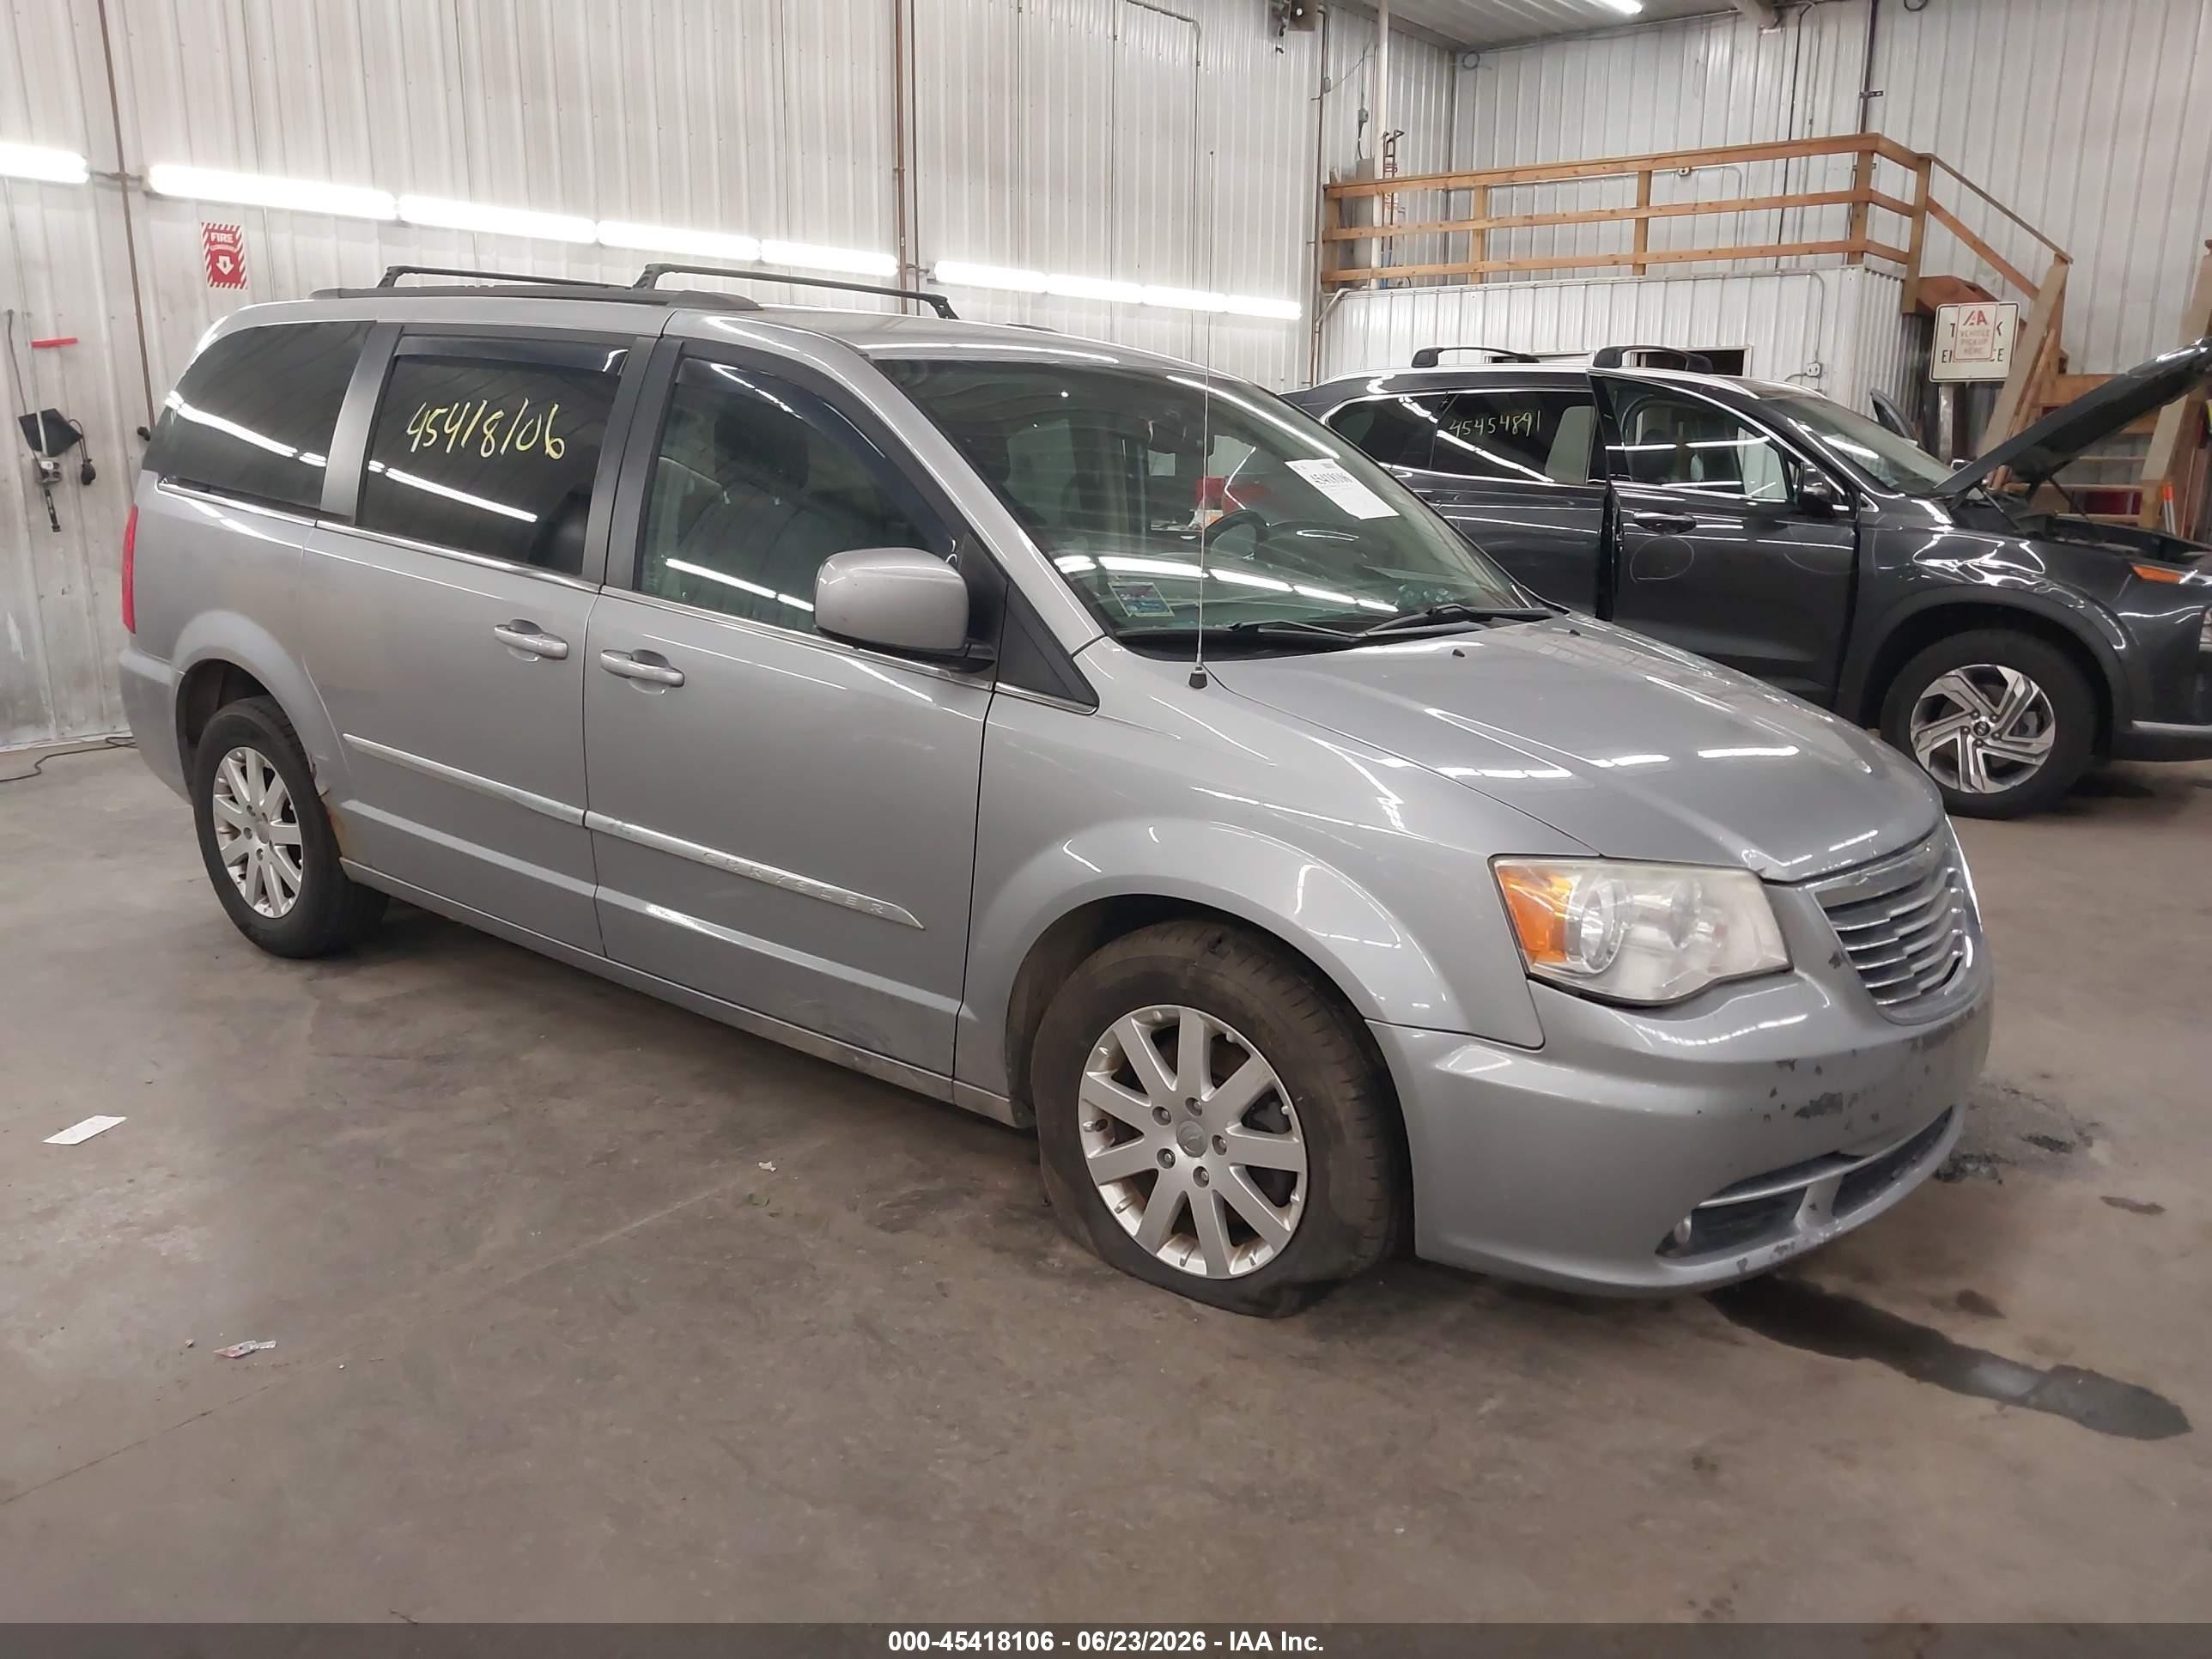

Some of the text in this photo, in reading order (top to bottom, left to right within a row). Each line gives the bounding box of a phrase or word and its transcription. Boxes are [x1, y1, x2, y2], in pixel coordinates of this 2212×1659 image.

[210, 232, 234, 243] FIRE
[1449, 410, 1540, 439] 45454891
[702, 852, 884, 915] CHRYSLER
